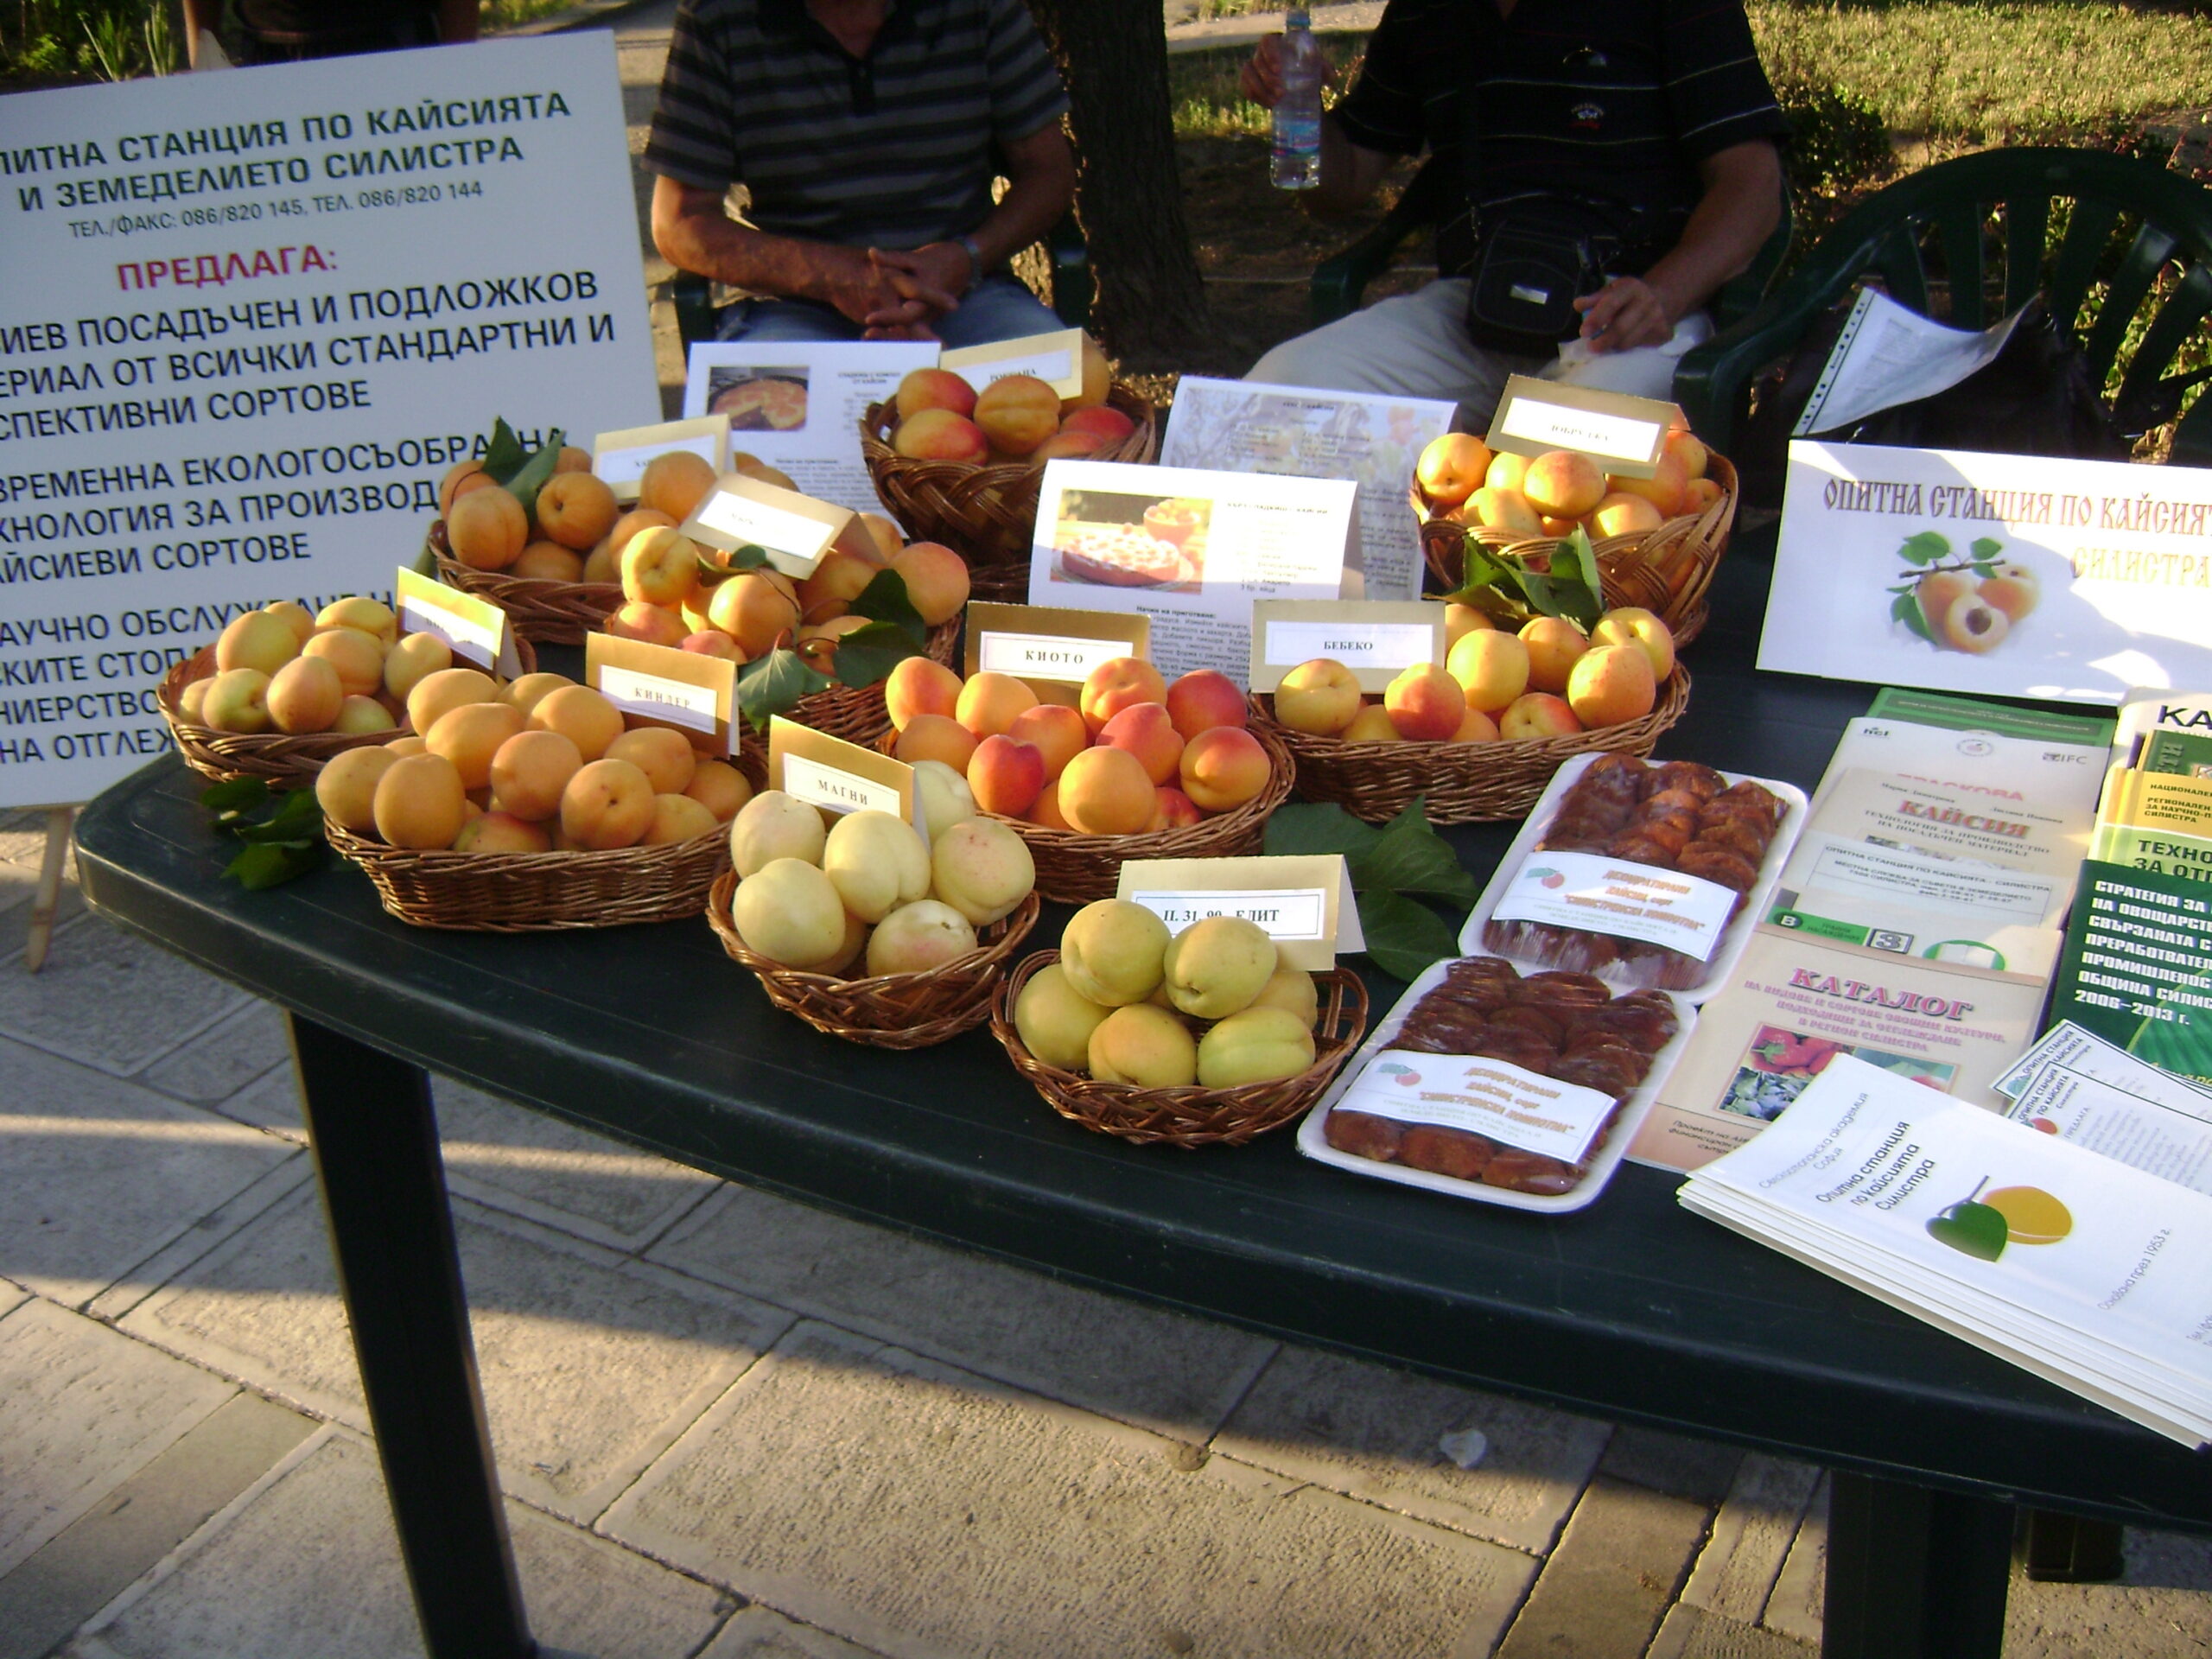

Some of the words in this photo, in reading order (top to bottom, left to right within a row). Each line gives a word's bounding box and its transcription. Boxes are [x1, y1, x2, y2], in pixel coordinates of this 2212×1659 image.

[118, 120, 289, 162] СТАНЦИЯ
[302, 113, 353, 143] ПО
[366, 92, 571, 137] КАЙСИЯТА
[19, 187, 44, 212] И
[57, 156, 310, 208] ЗЕМЕДЕЛИЕТО
[324, 137, 524, 180] СИЛИСТРА
[182, 202, 263, 228] 086/820
[312, 194, 353, 213] ТЕЛ.
[359, 184, 442, 208] 086/820
[449, 181, 484, 200] 144
[118, 244, 339, 290] ПРЕДЛАГА:
[78, 298, 302, 346] ПОСАДЪЧЕН
[312, 296, 338, 324] И
[349, 271, 599, 321] ПОДЛОЖКОВ
[113, 356, 156, 386] ОТ
[169, 340, 317, 382] ВСИЧКИ
[328, 317, 577, 365] СТАНДАРТНИ
[588, 313, 615, 343] И
[208, 380, 371, 422] СОРТОВЕ
[183, 428, 568, 486] ЕКОЛОГОСЪОБРАНА
[185, 499, 231, 528] ЗА
[239, 480, 444, 523] ПРОИЗВОД
[1822, 479, 1923, 517] ОПИТНА
[1929, 486, 2054, 530] СТАНЦИЯ
[2059, 493, 2093, 527] ПО
[0, 547, 143, 585] ЙСИЕВИ
[153, 532, 312, 570] СОРТОВЕ
[2071, 546, 2210, 588] СИЛИСТРА
[0, 614, 111, 646] АУЧНО
[1323, 639, 1374, 652] БЕБЕКО
[0, 655, 88, 686] КИТЕ
[98, 647, 188, 678] СТОП
[1025, 649, 1084, 664] КИОТО
[2157, 704, 2212, 730] КА
[0, 738, 45, 765] НА
[817, 779, 869, 805] МАГНИ
[1897, 799, 2031, 839] КАЙСИЯ
[2144, 810, 2197, 823] СИЛИСТРА
[1163, 910, 1179, 923] П.
[2091, 897, 2115, 912] НА
[2094, 880, 2180, 908] СТРАТЕГИЯ
[2183, 898, 2207, 913] ЗА
[2088, 914, 2196, 948] СВЪРЗАНАТА
[1744, 980, 1761, 991] НА
[1764, 984, 1813, 1004] ВИДОВЕ
[1827, 1000, 1883, 1019] СОРТОВЕ
[1788, 967, 1974, 1021] КАТАЛОГ
[2077, 969, 2152, 997] ОБЩИНА
[1829, 1091, 1869, 1139] академия
[1813, 1146, 1845, 1172] София
[1815, 1172, 1865, 1204] Опитна
[1860, 1121, 1910, 1176] станция
[1849, 1192, 1868, 1207] по
[1866, 1143, 1920, 1199] кайсията
[1874, 1158, 1936, 1211] Силистра
[2144, 1235, 2166, 1256] 1953
